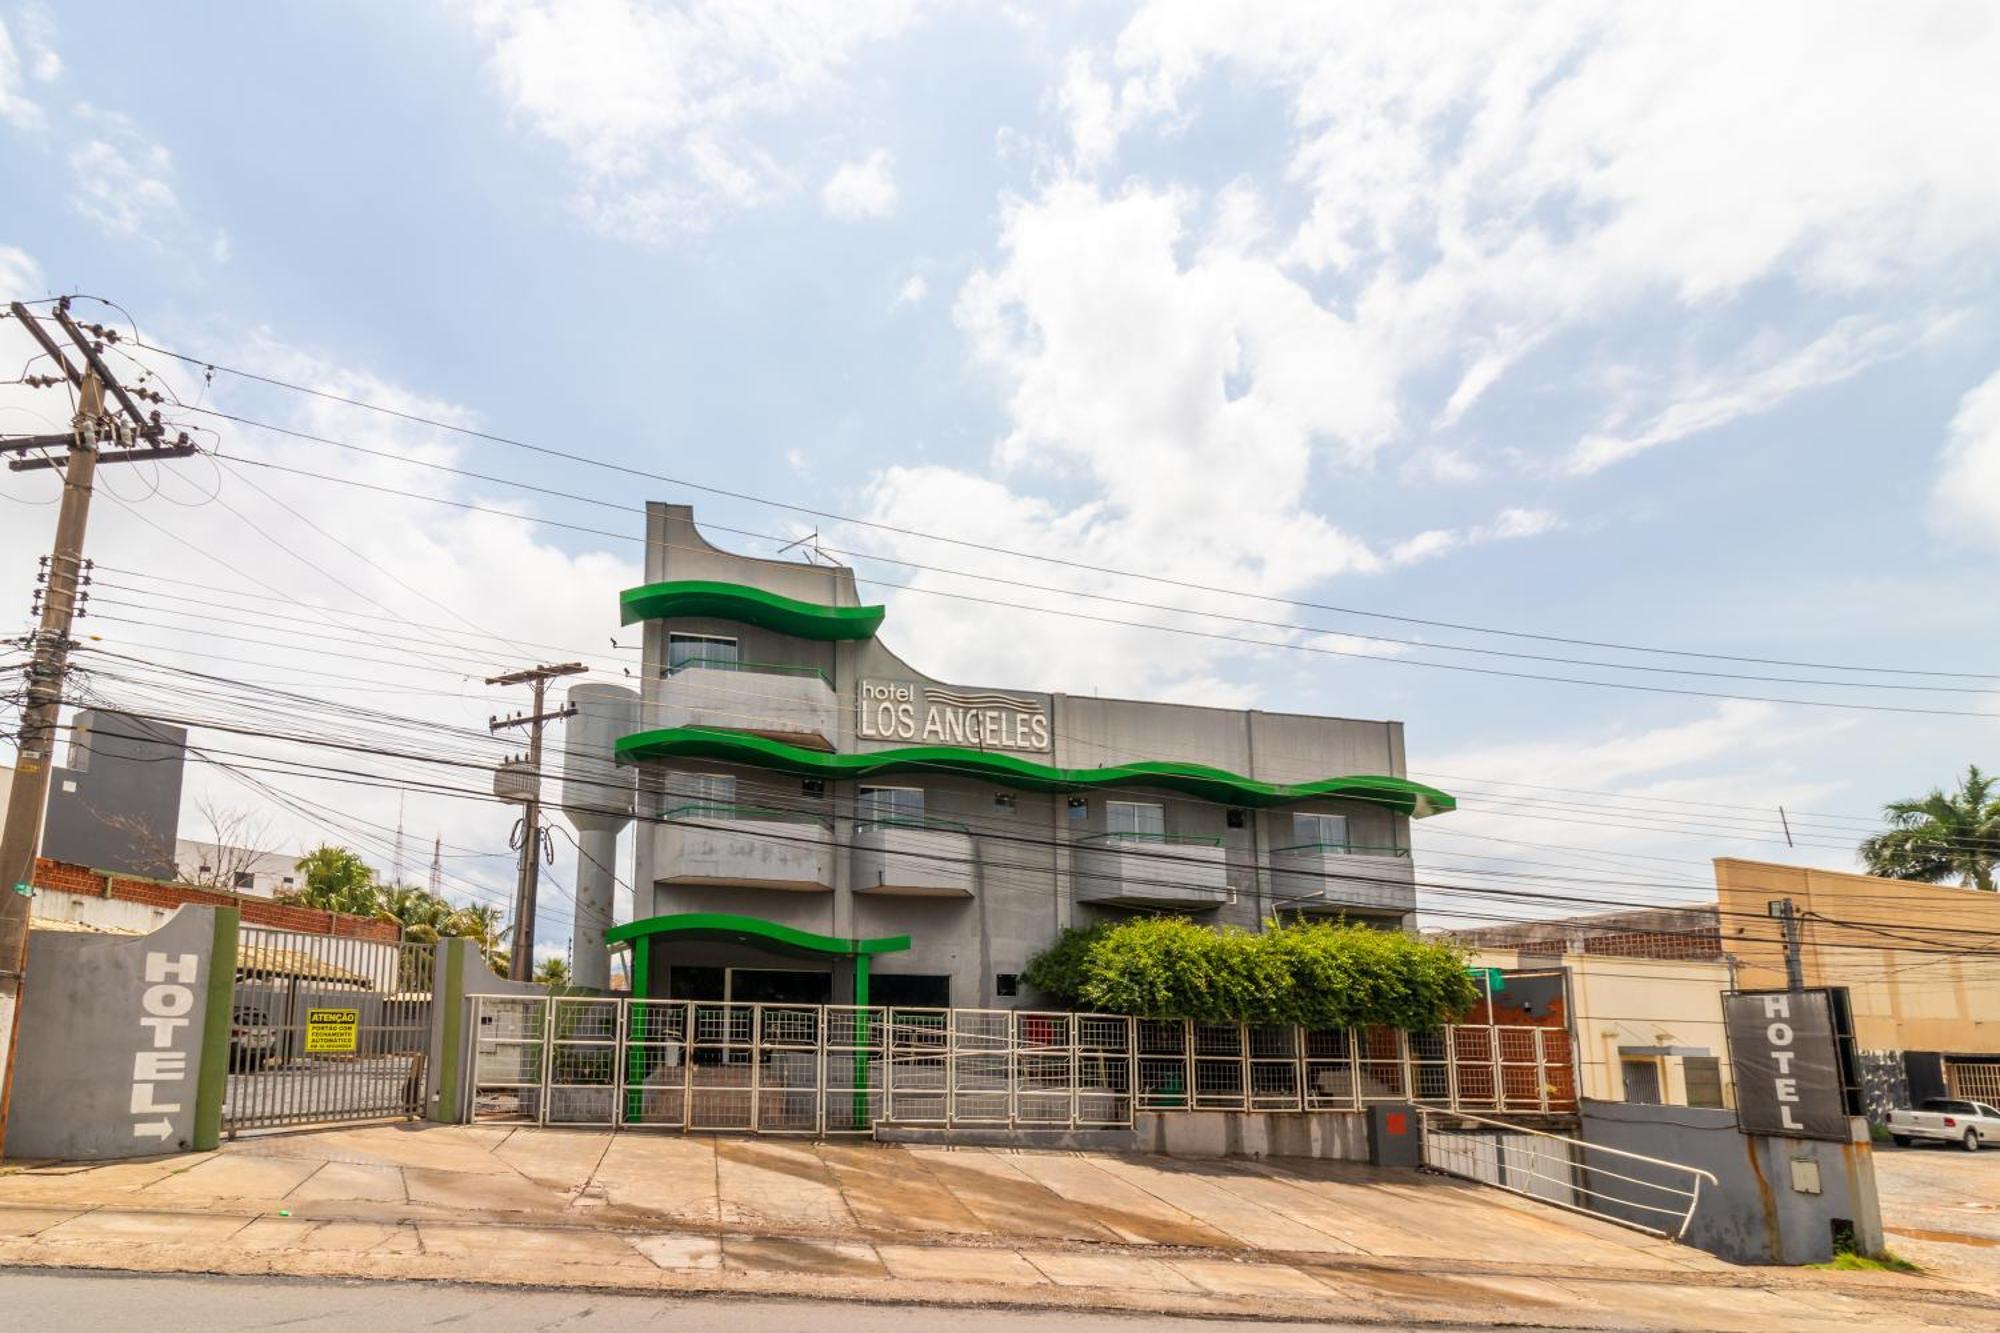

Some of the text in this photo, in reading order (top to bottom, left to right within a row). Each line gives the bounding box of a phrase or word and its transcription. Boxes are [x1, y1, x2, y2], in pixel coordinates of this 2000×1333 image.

[862, 680, 913, 702] hotel
[862, 701, 1049, 748] LOS ANGELES
[131, 952, 198, 1113] HOTEL
[311, 1013, 354, 1022] ATENÇÃO
[1764, 995, 1803, 1130] HOTEL
